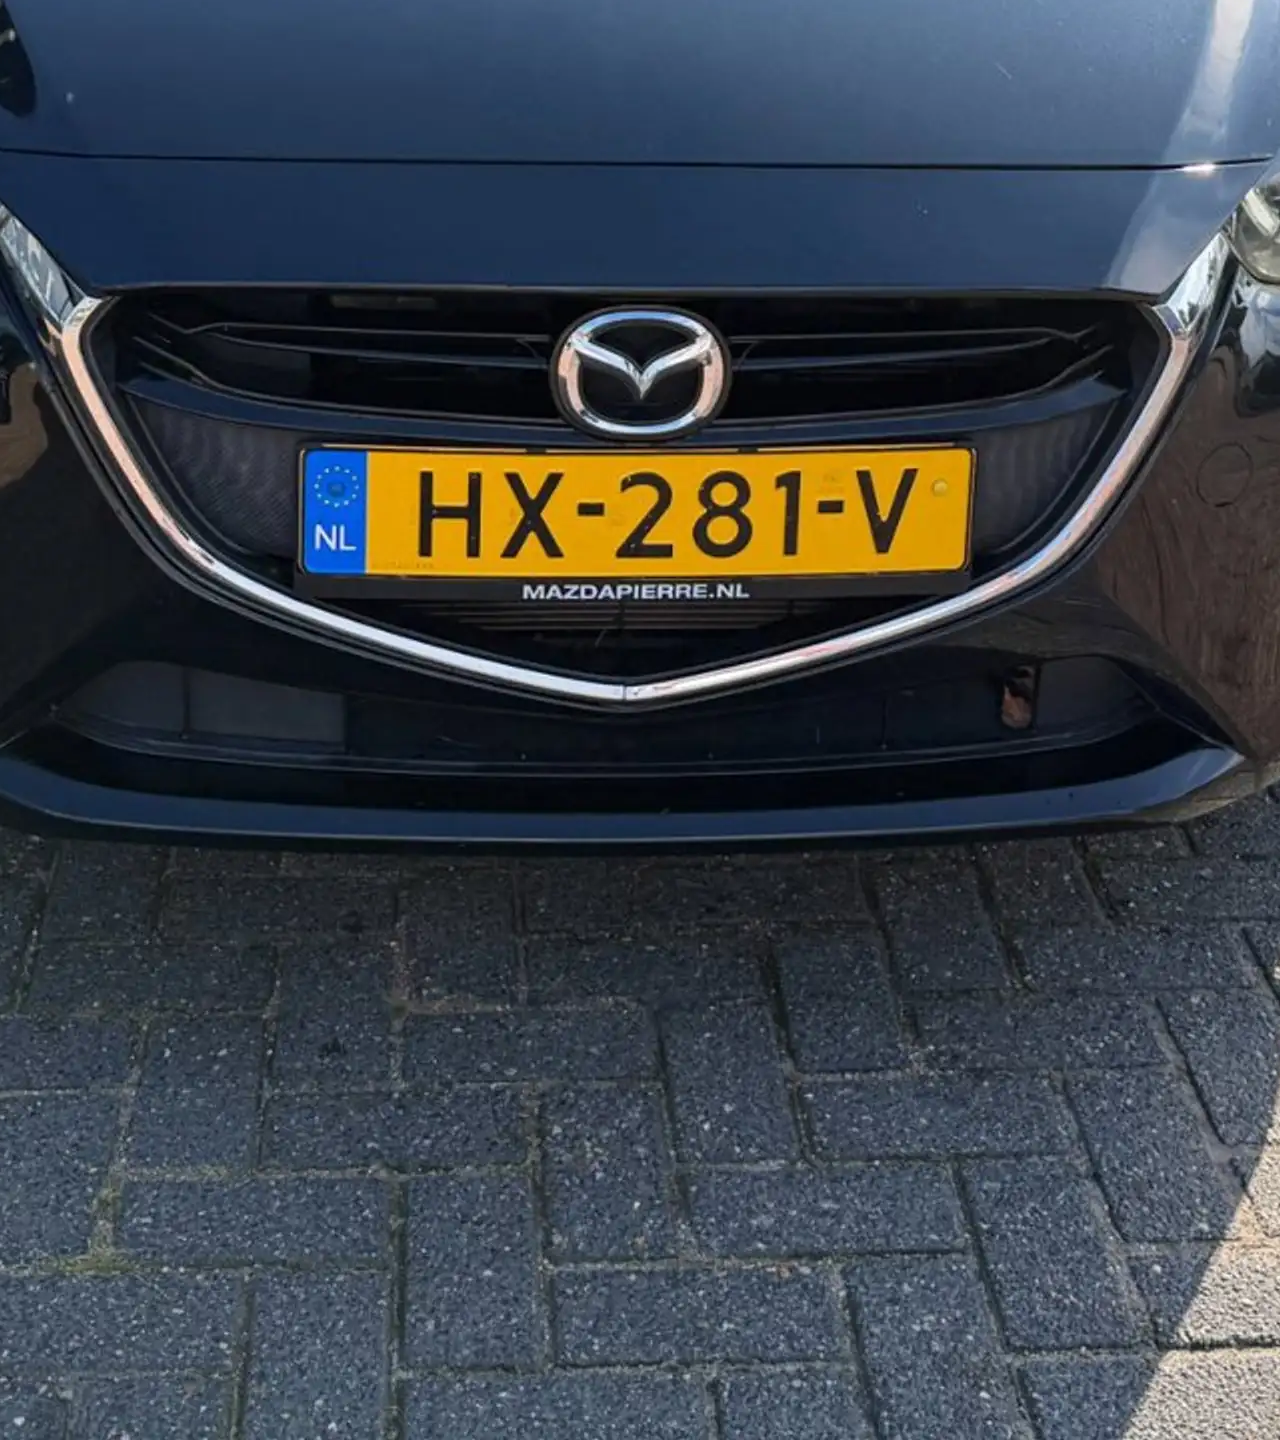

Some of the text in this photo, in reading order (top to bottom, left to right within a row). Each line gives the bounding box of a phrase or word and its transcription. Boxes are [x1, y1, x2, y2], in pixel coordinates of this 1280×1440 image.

[418, 468, 919, 559] HX-281-V
[314, 524, 357, 552] NL
[522, 583, 750, 601] MAZDAPIERRE.NL
